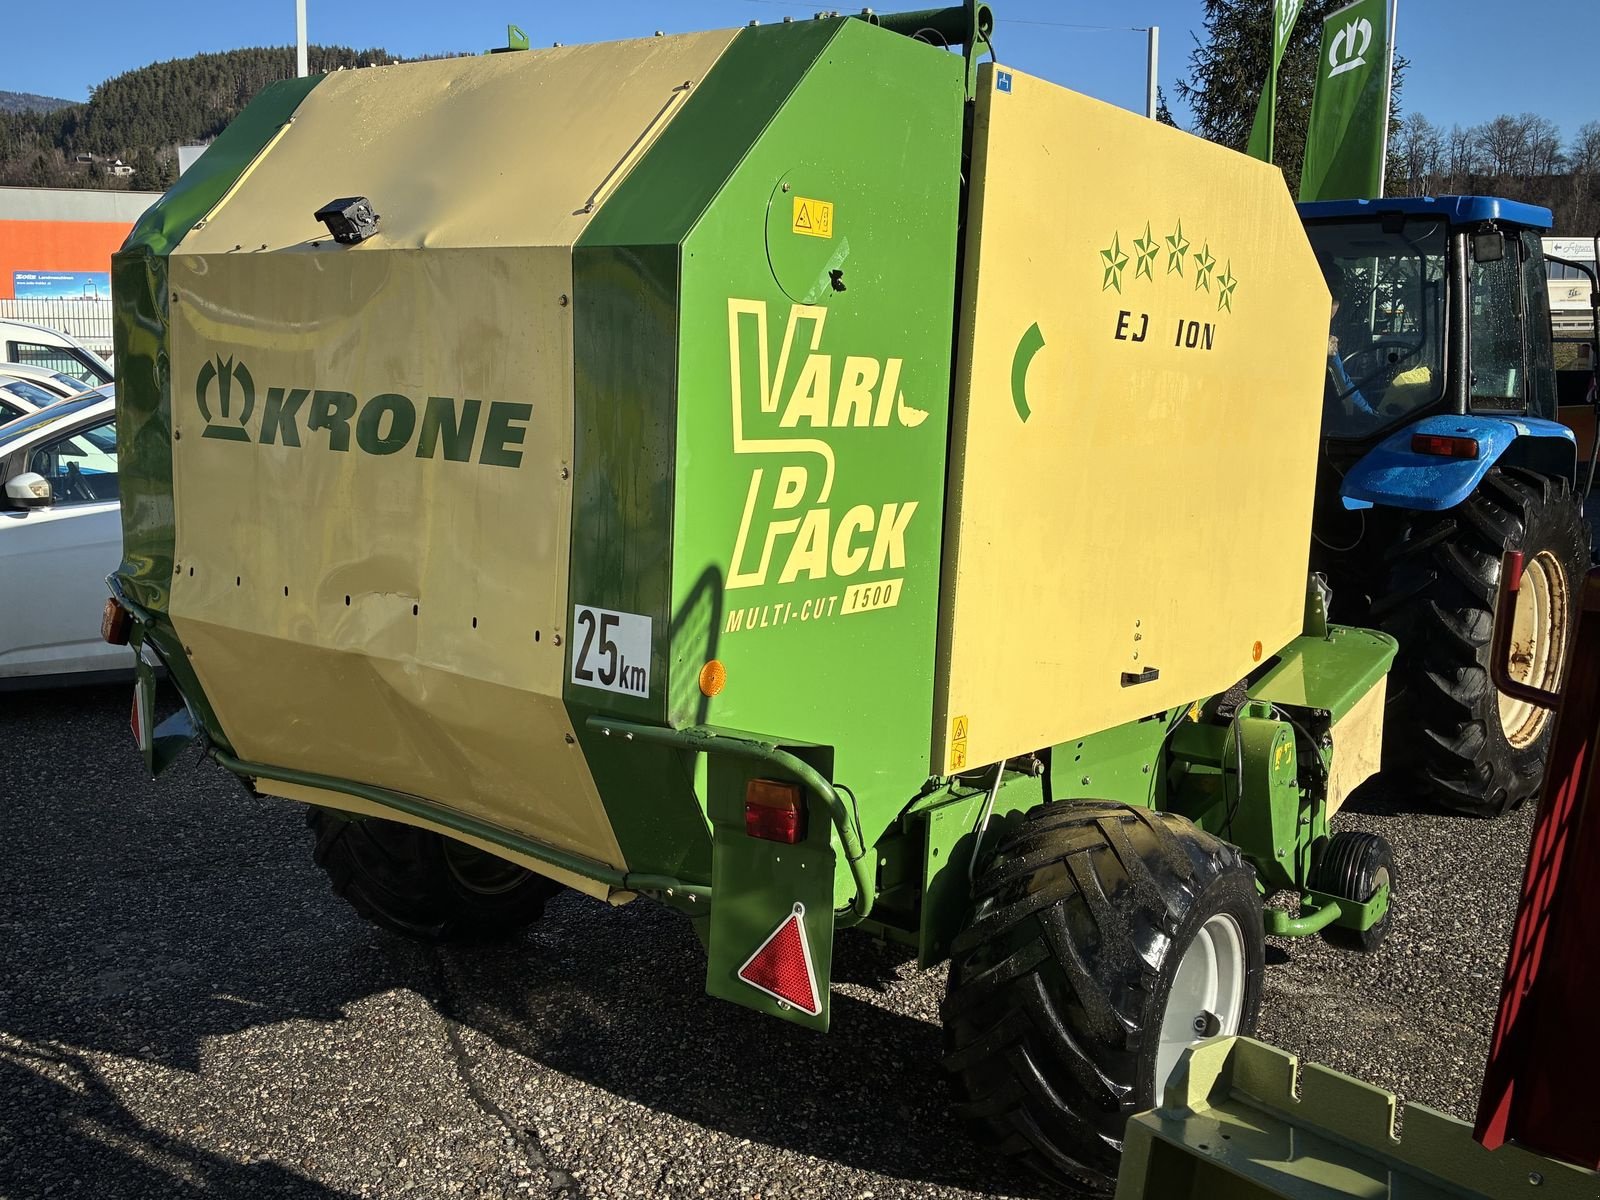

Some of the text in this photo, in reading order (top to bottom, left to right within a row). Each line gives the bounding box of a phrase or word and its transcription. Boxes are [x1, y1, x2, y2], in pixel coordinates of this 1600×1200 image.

[258, 387, 533, 469] KRONE
[725, 438, 920, 590] PACK
[725, 584, 892, 633] MULTI-CUT 1500
